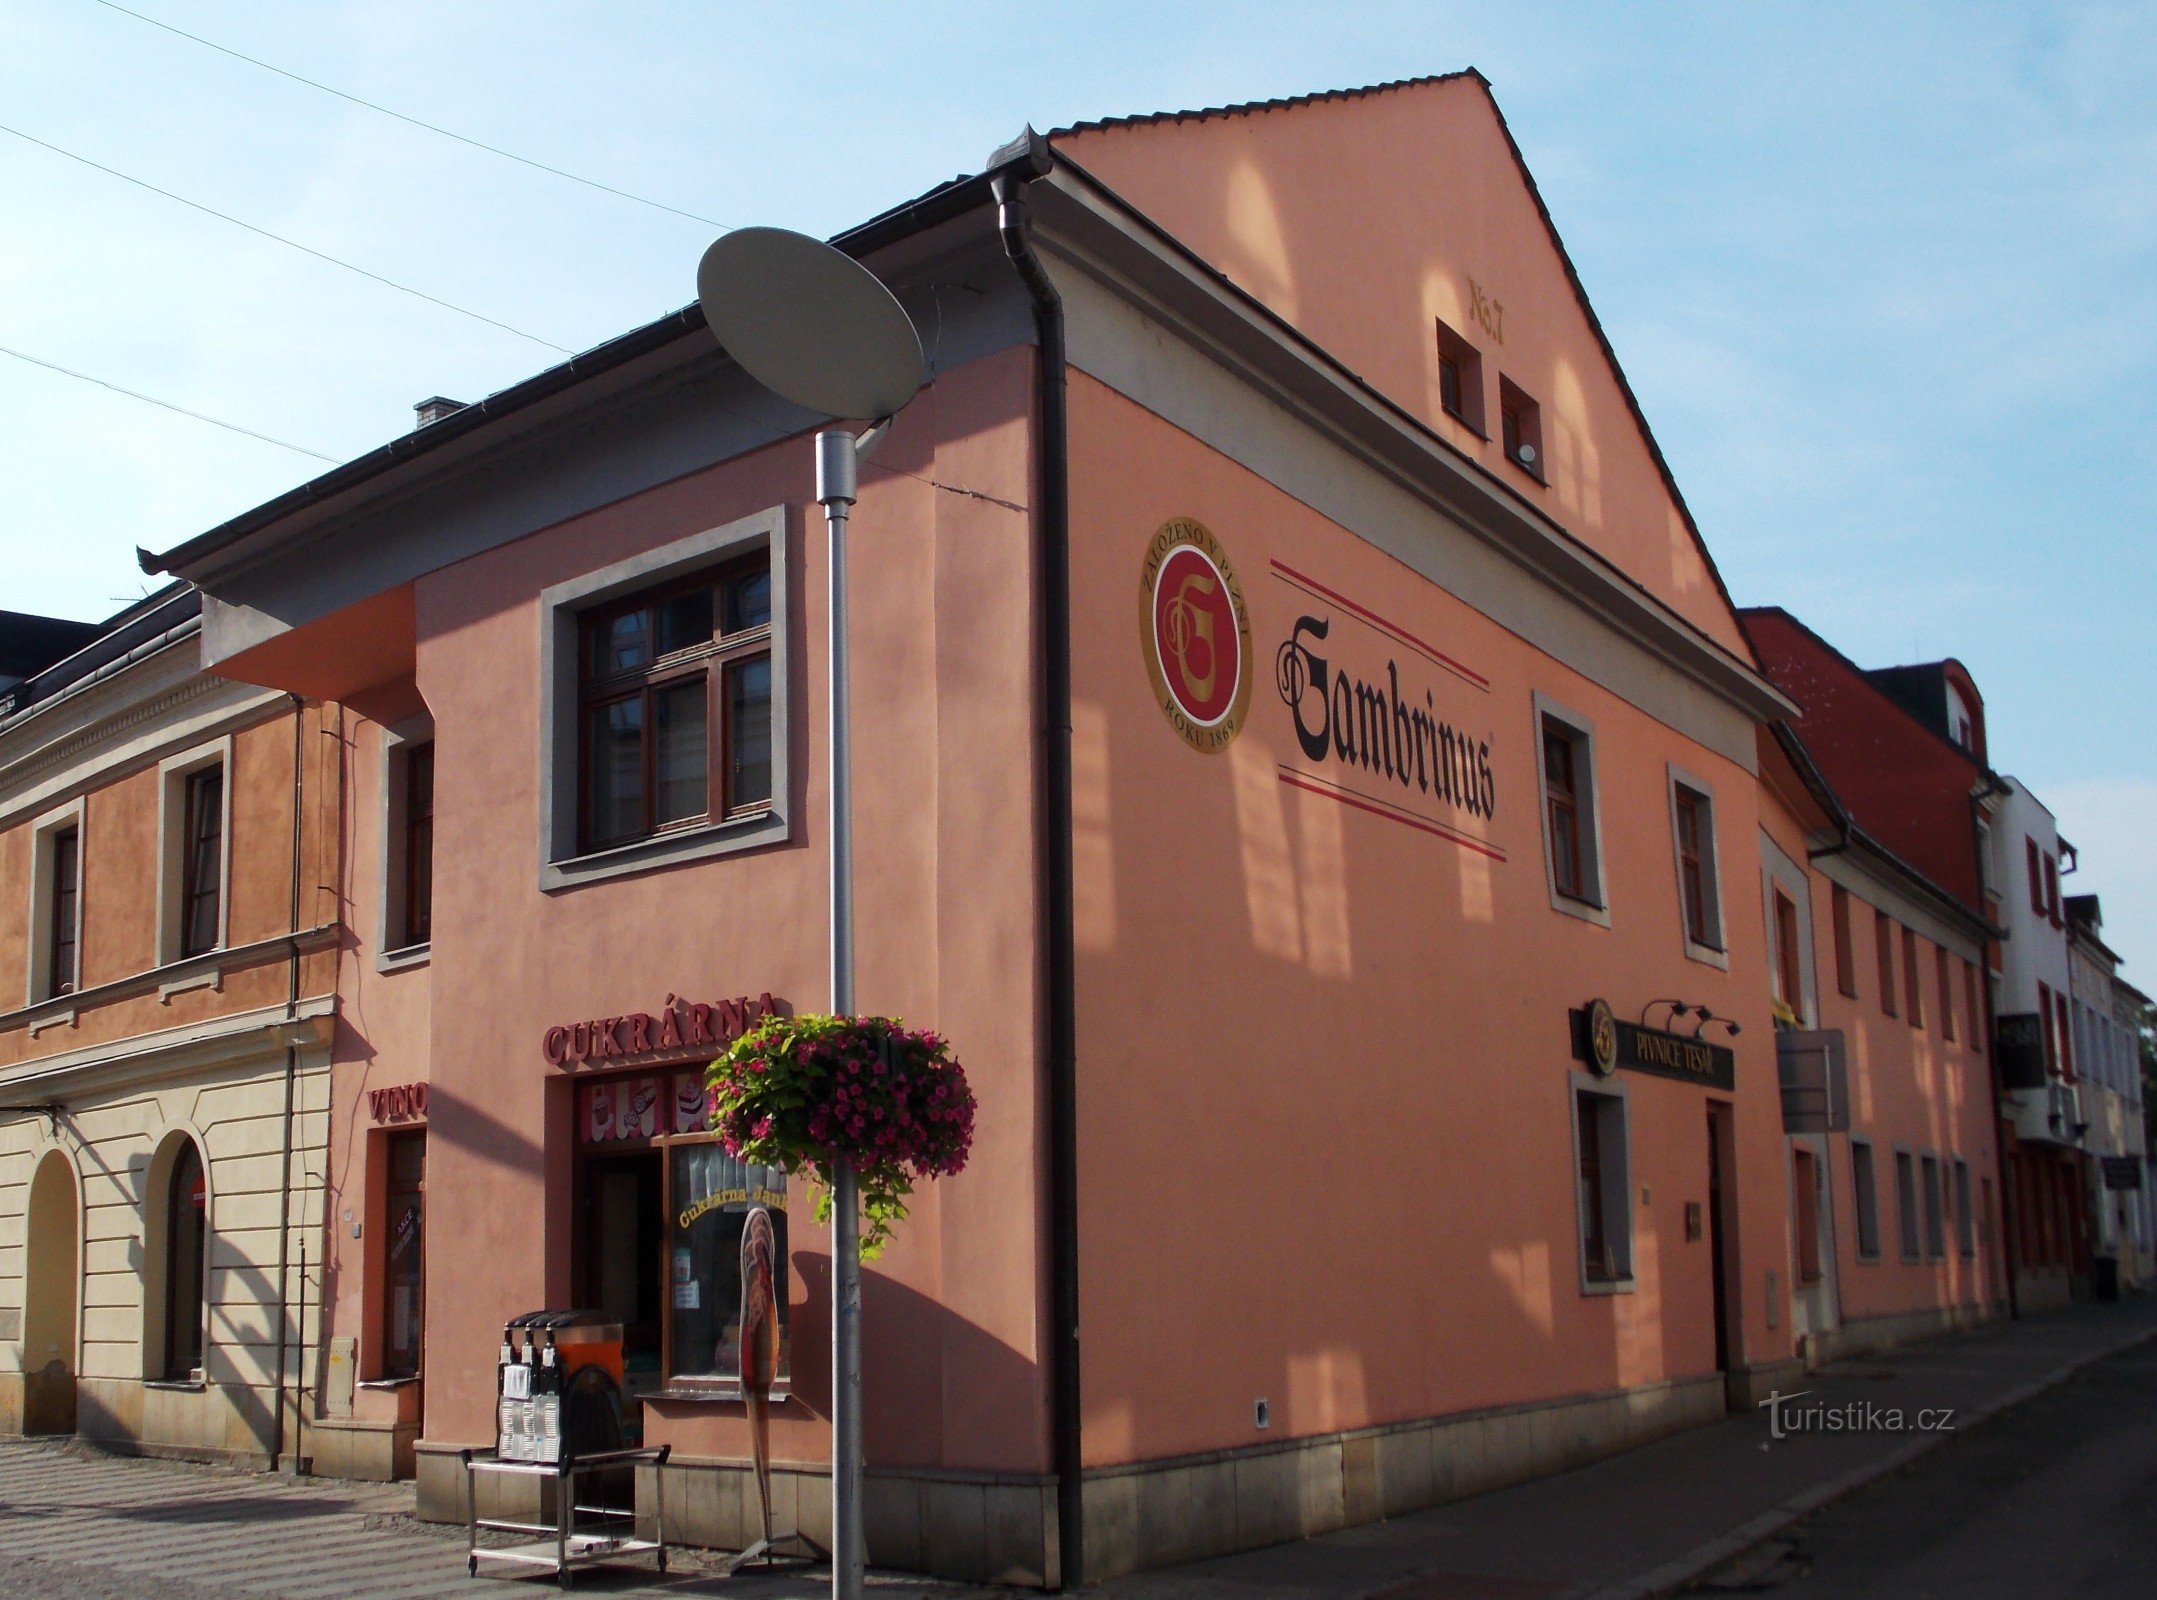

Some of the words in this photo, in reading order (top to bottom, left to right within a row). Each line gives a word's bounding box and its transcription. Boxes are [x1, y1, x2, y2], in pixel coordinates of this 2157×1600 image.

[1143, 522, 1204, 593] ZALOŽENO
[1208, 539, 1218, 554] V
[1165, 699, 1204, 748] ROKU
[1209, 719, 1234, 747] 1869
[1276, 615, 1495, 821] Gambrinus
[542, 992, 778, 1066] CUKRÁRNA
[1635, 1031, 1681, 1067] PIVNICE
[679, 1188, 747, 1229] Cukrárna
